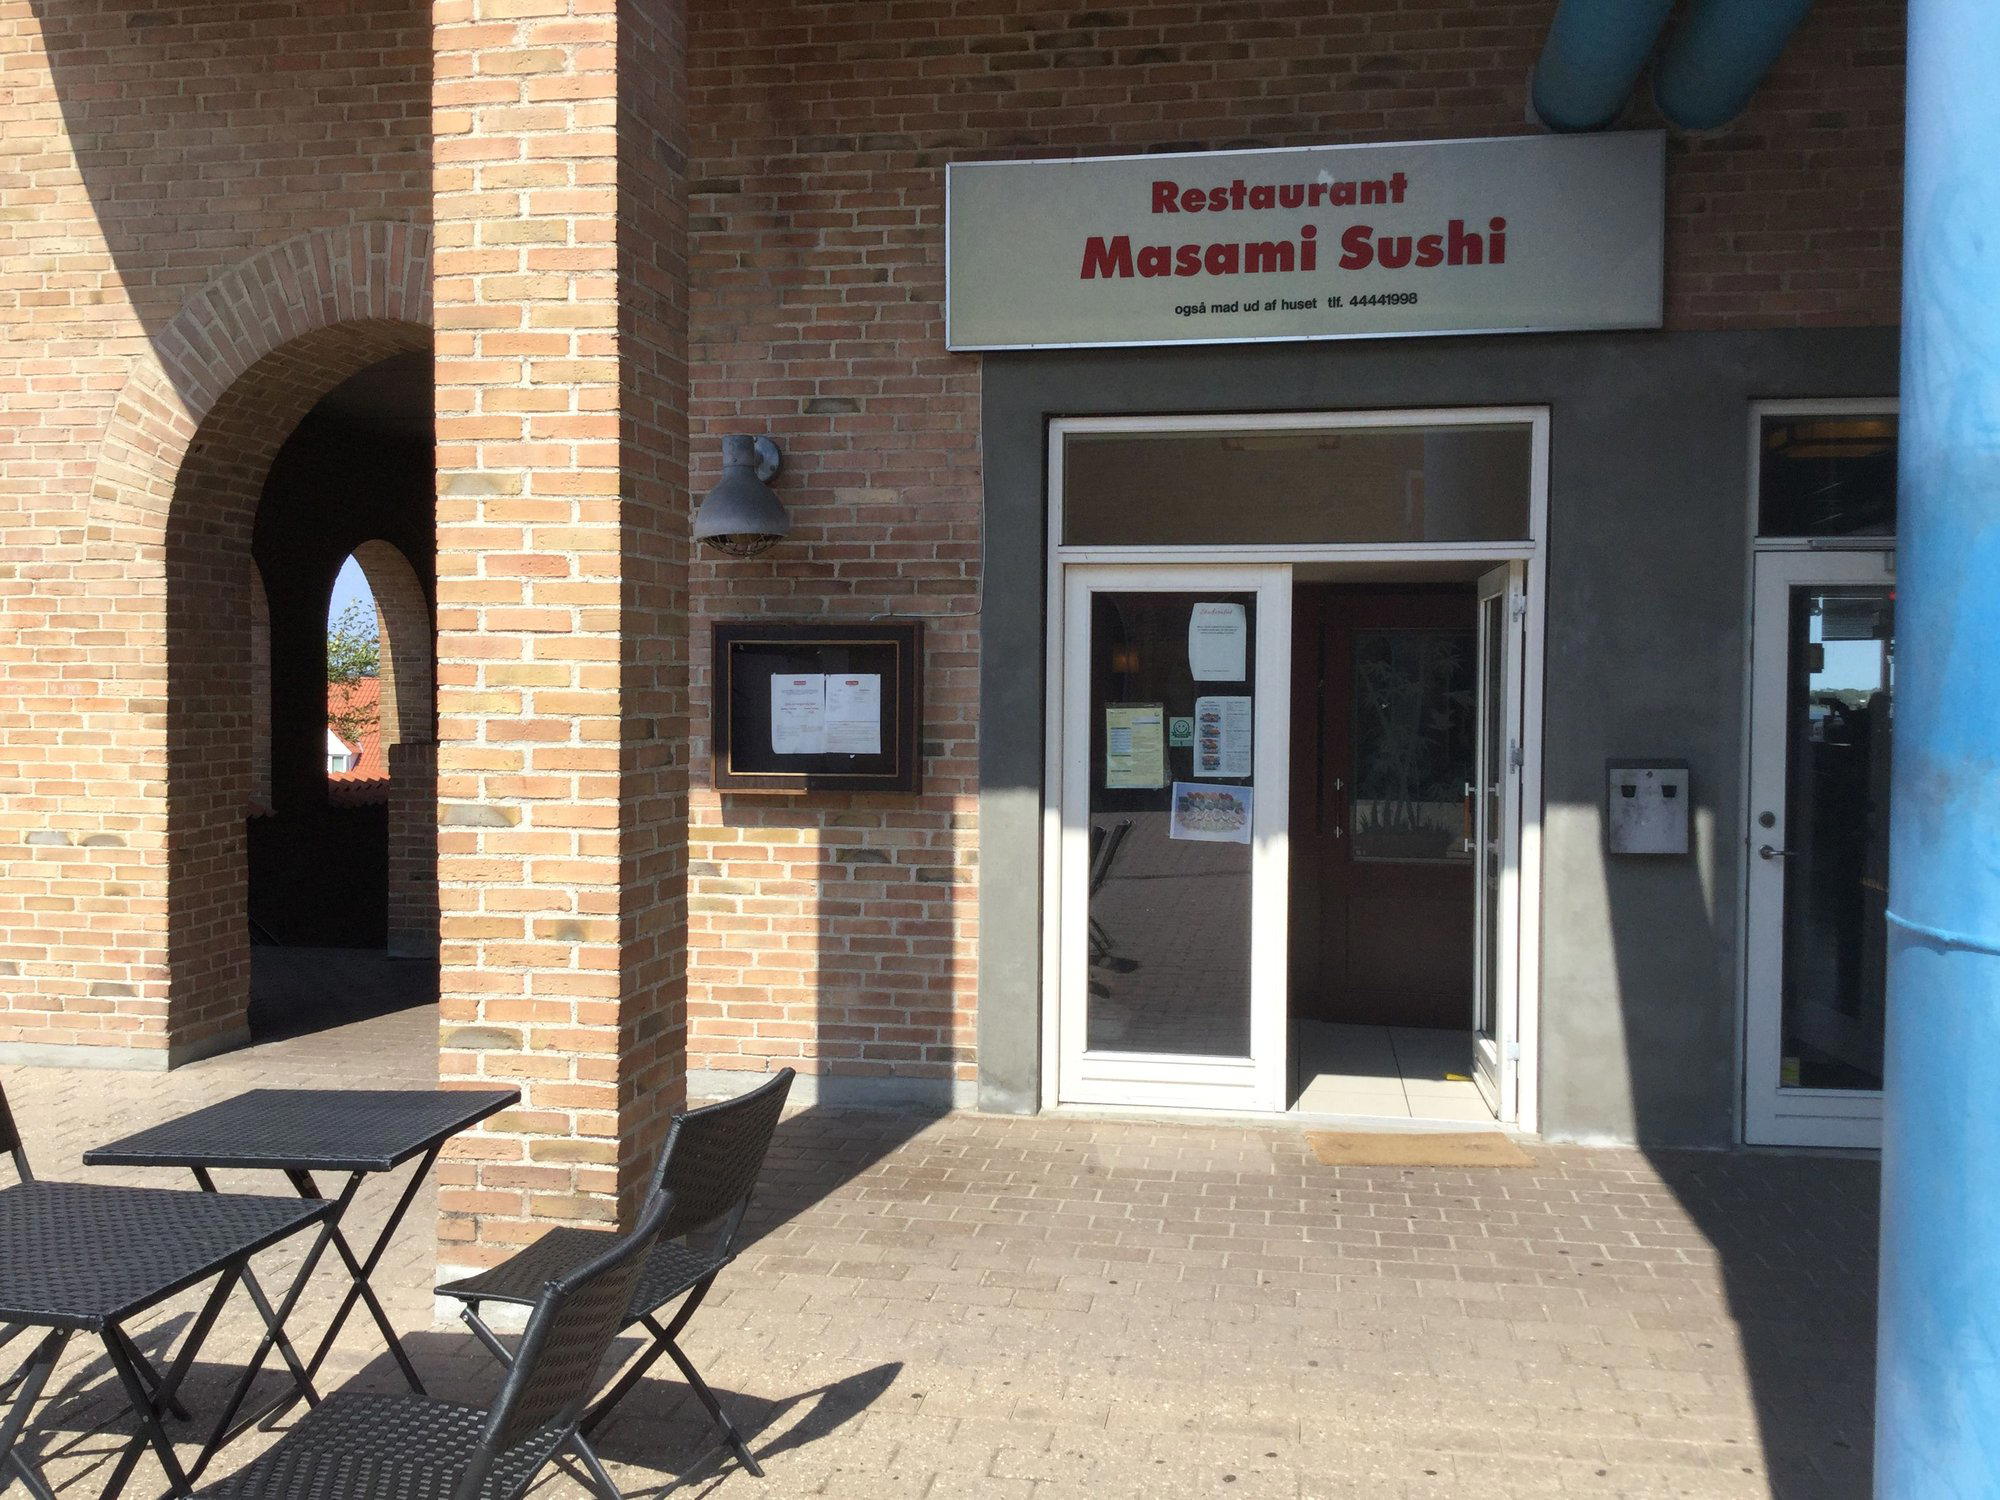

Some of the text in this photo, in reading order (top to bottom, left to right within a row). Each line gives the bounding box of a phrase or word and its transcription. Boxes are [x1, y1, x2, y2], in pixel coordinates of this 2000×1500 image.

[1151, 172, 1408, 214] Restaurant
[1080, 216, 1507, 280] Masami Sushi
[1174, 292, 1418, 316] også mad ud af huset tlf. 44441998
